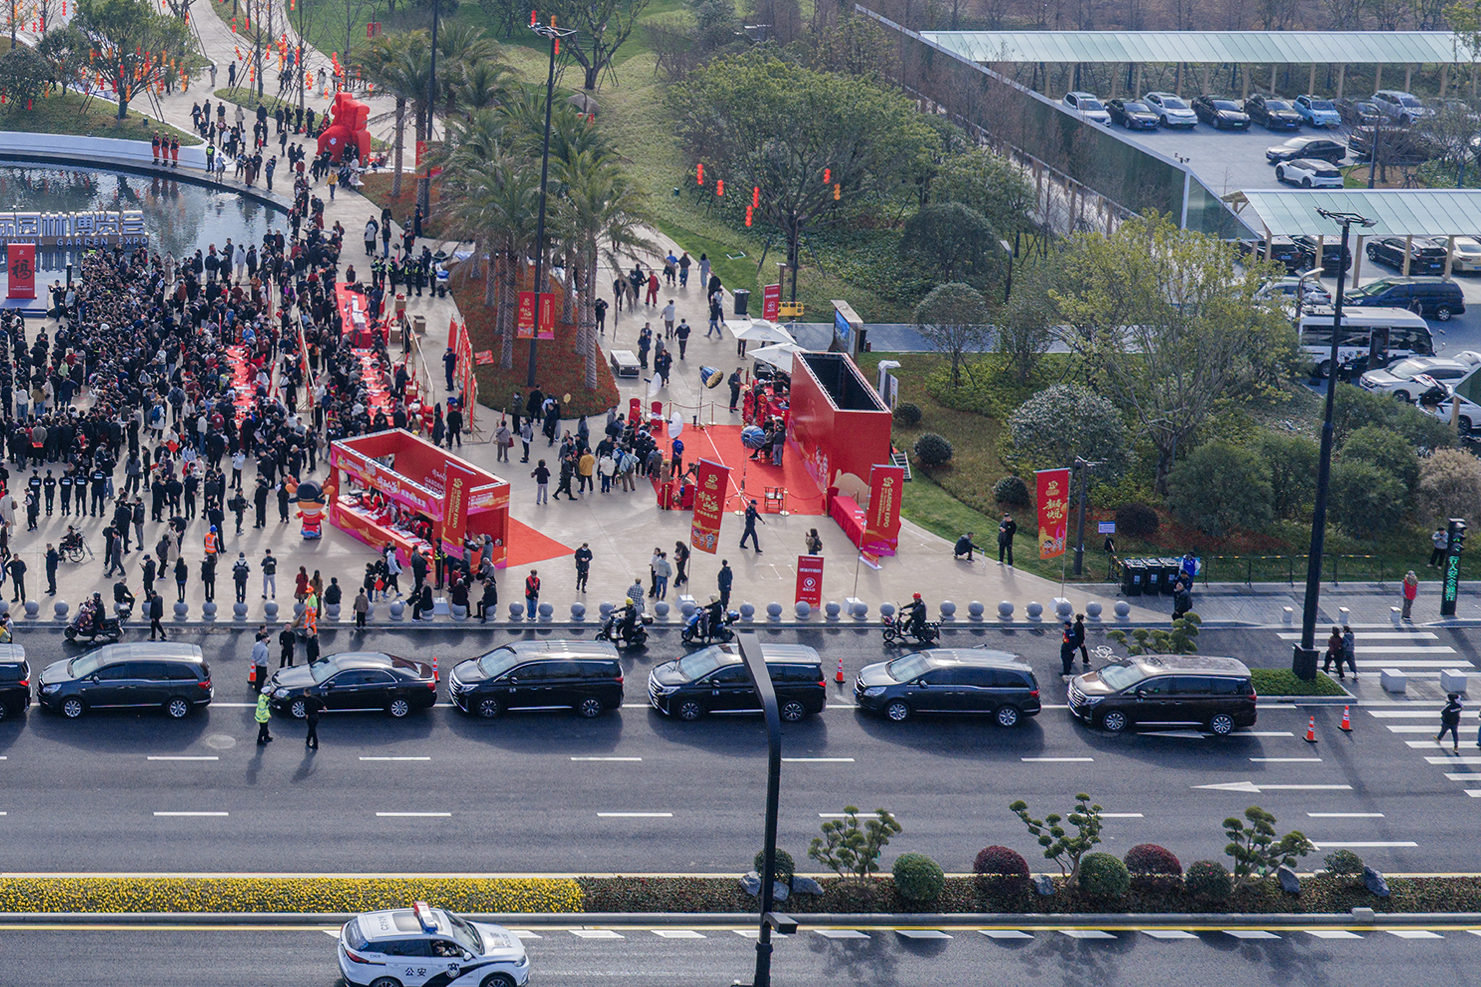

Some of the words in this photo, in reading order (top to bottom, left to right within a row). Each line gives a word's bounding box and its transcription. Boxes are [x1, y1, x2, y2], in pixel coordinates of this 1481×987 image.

[118, 237, 149, 245] EXPO
[10, 259, 33, 280] 福
[404, 967, 427, 977] 公安
